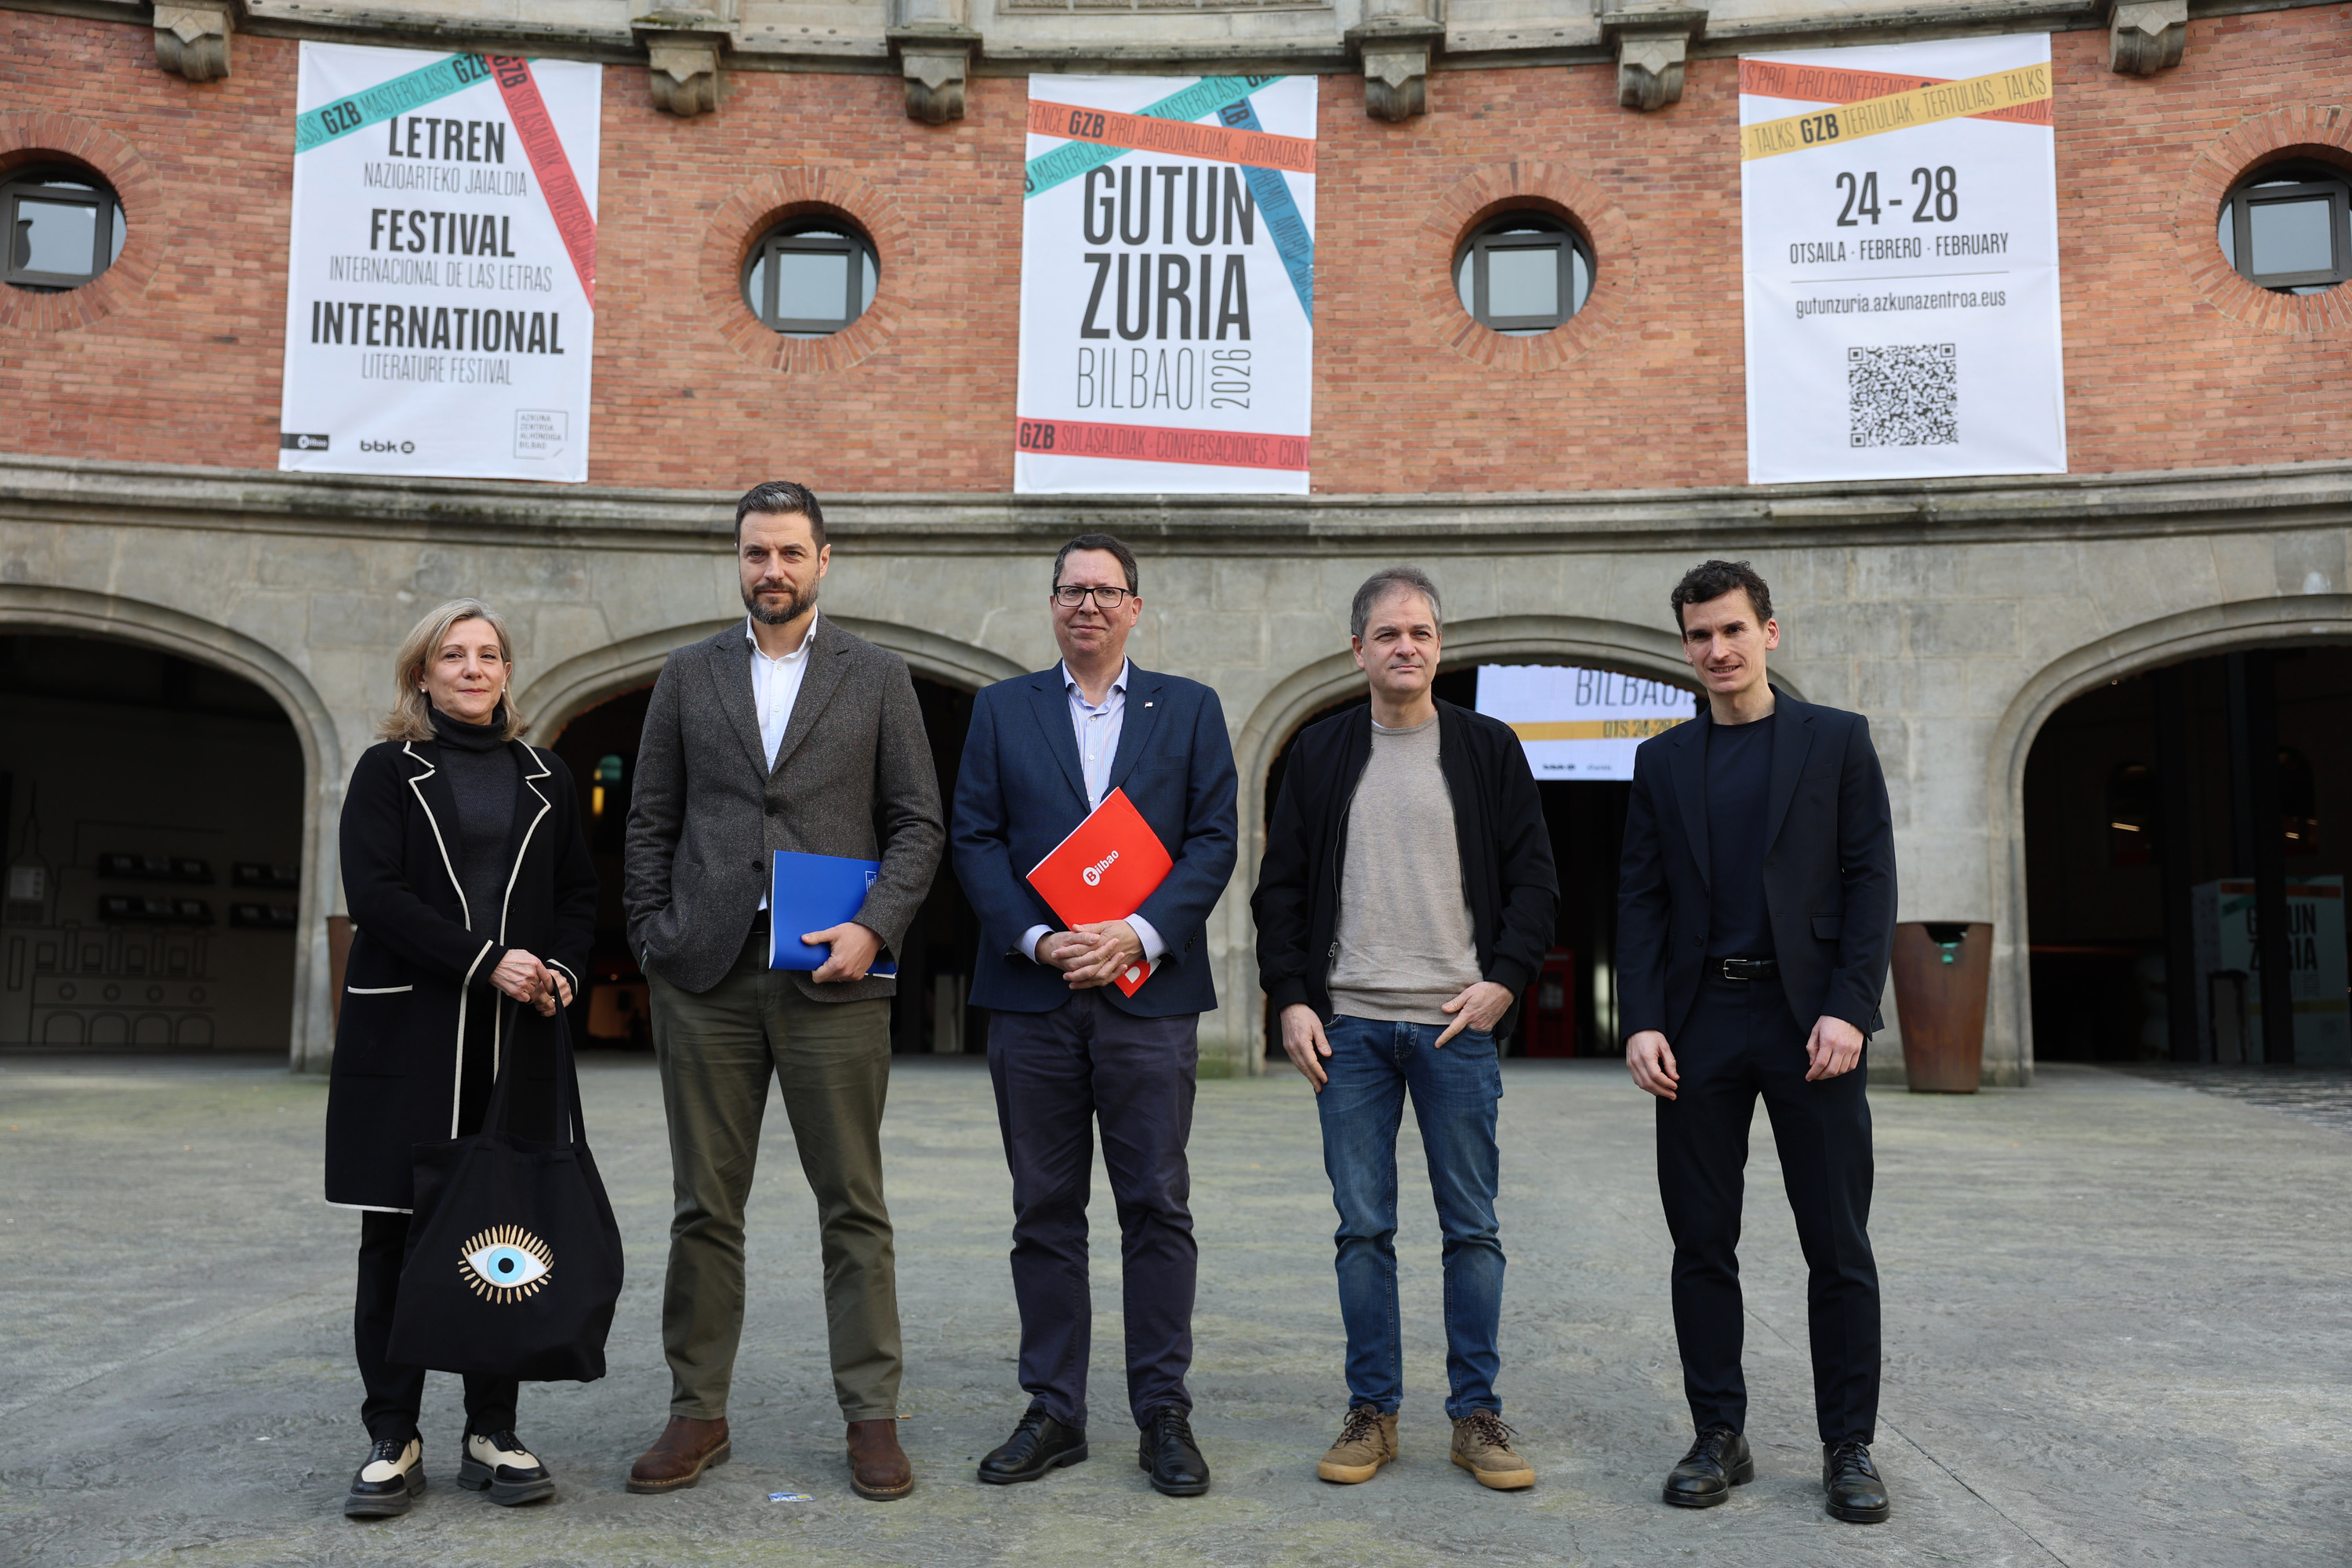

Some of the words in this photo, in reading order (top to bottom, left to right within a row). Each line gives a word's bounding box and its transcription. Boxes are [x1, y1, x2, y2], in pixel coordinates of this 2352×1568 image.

[321, 101, 363, 134] GZB
[359, 65, 456, 120] MASTERCLASS
[452, 54, 492, 84] GZB
[492, 56, 528, 89] GZB
[1757, 65, 1786, 94] PRO
[1795, 69, 1825, 97] PRO
[1755, 122, 1795, 153] TALKS
[1801, 114, 1838, 143] GZB
[1842, 97, 1915, 135] TERTULIAK
[1922, 79, 1995, 118] TERTULIAS
[2003, 69, 2048, 100] TALKS
[389, 115, 504, 164] LETREN
[1069, 111, 1105, 138] GZB
[1108, 116, 1136, 144] PRO
[1138, 122, 1232, 158] JARDUNALDIAK
[1240, 136, 1309, 169] JORNADAS
[365, 162, 460, 194] NAZIOARTEKO
[465, 169, 527, 197] JAIALDIA
[1033, 142, 1121, 187] MASTERCLAS
[1083, 165, 1254, 246] GUTUN
[370, 209, 515, 257] FESTIVAL
[1271, 215, 1310, 260] AWARD
[1790, 241, 1846, 264] OTSAILA
[1860, 238, 1921, 261] FEBRERO
[1936, 233, 2009, 257] FEBRUARY
[330, 256, 440, 287] INTERNACIONAL
[447, 262, 463, 288] DE
[470, 263, 495, 290] LAS
[500, 265, 552, 292] LETRAS
[1080, 253, 1251, 340] ZURIA
[1795, 290, 2006, 319] gutunzuria.azkunazentroa.eus
[312, 301, 564, 354] INTERNATIONAL
[361, 353, 445, 382] LITERATURE
[451, 357, 512, 385] FESTIVAL
[1077, 347, 1193, 410] BILBAO
[1210, 348, 1251, 409] 2026
[360, 440, 397, 452] bbk
[1019, 422, 1055, 449] GZB
[1061, 425, 1146, 456] SOLASALDIAK
[1156, 432, 1269, 464] CONVERSACIONES
[1083, 850, 1120, 886] Bilbao
